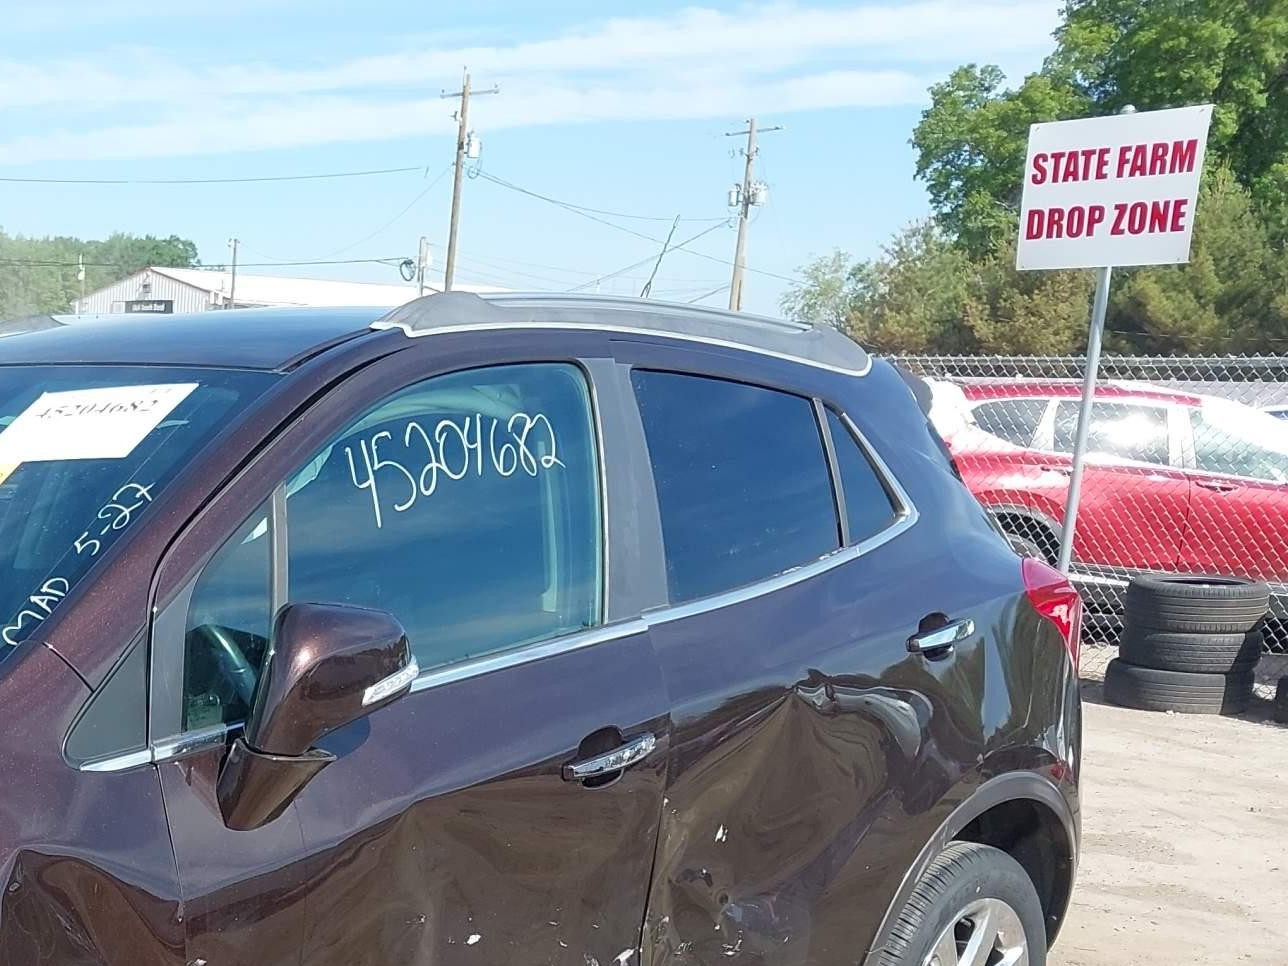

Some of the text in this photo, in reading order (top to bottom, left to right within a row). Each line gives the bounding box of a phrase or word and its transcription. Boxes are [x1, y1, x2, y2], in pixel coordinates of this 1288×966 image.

[1031, 139, 1198, 185] STATE FARM
[1025, 199, 1189, 240] DROP ZONE
[344, 413, 566, 529] 45204682
[2, 482, 156, 646] MAD 5-27
